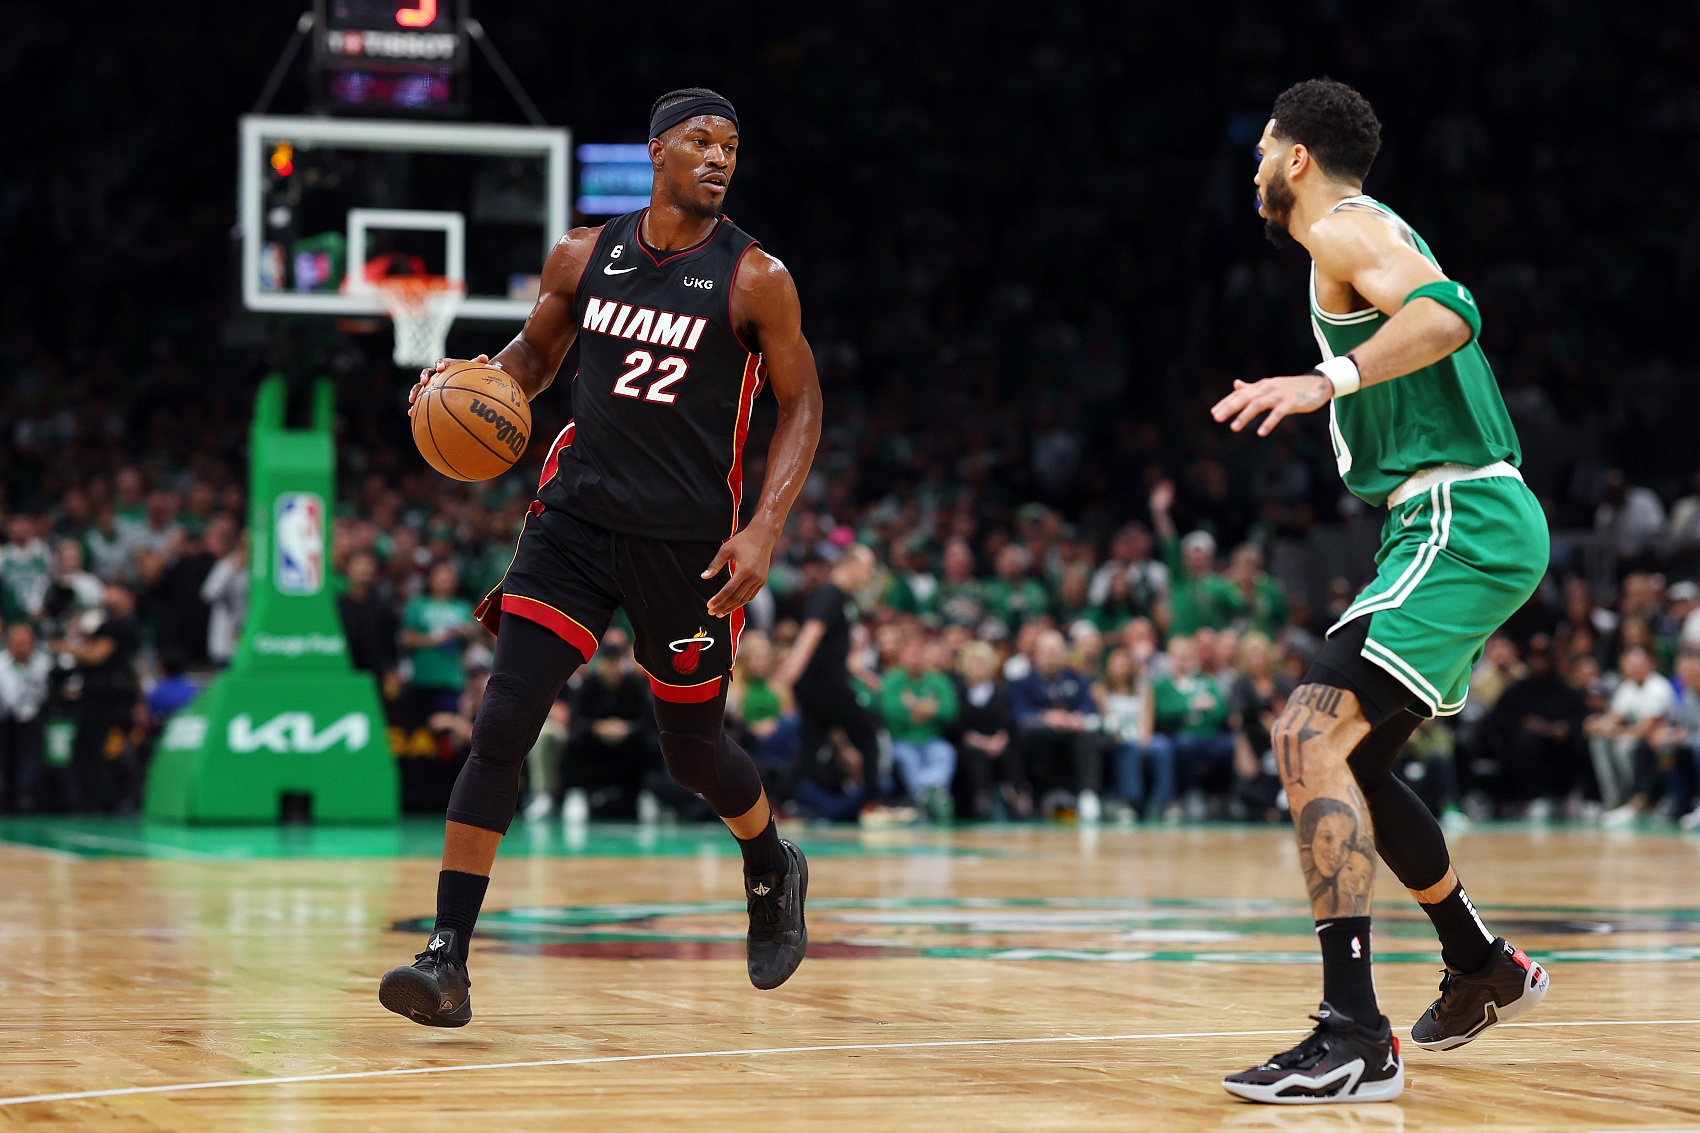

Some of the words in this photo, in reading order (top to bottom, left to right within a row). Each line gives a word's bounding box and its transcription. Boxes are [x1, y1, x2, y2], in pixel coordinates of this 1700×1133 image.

[610, 244, 624, 259] 6
[582, 296, 709, 352] MIAMI
[611, 348, 690, 405] 22
[469, 398, 527, 458] Wilson
